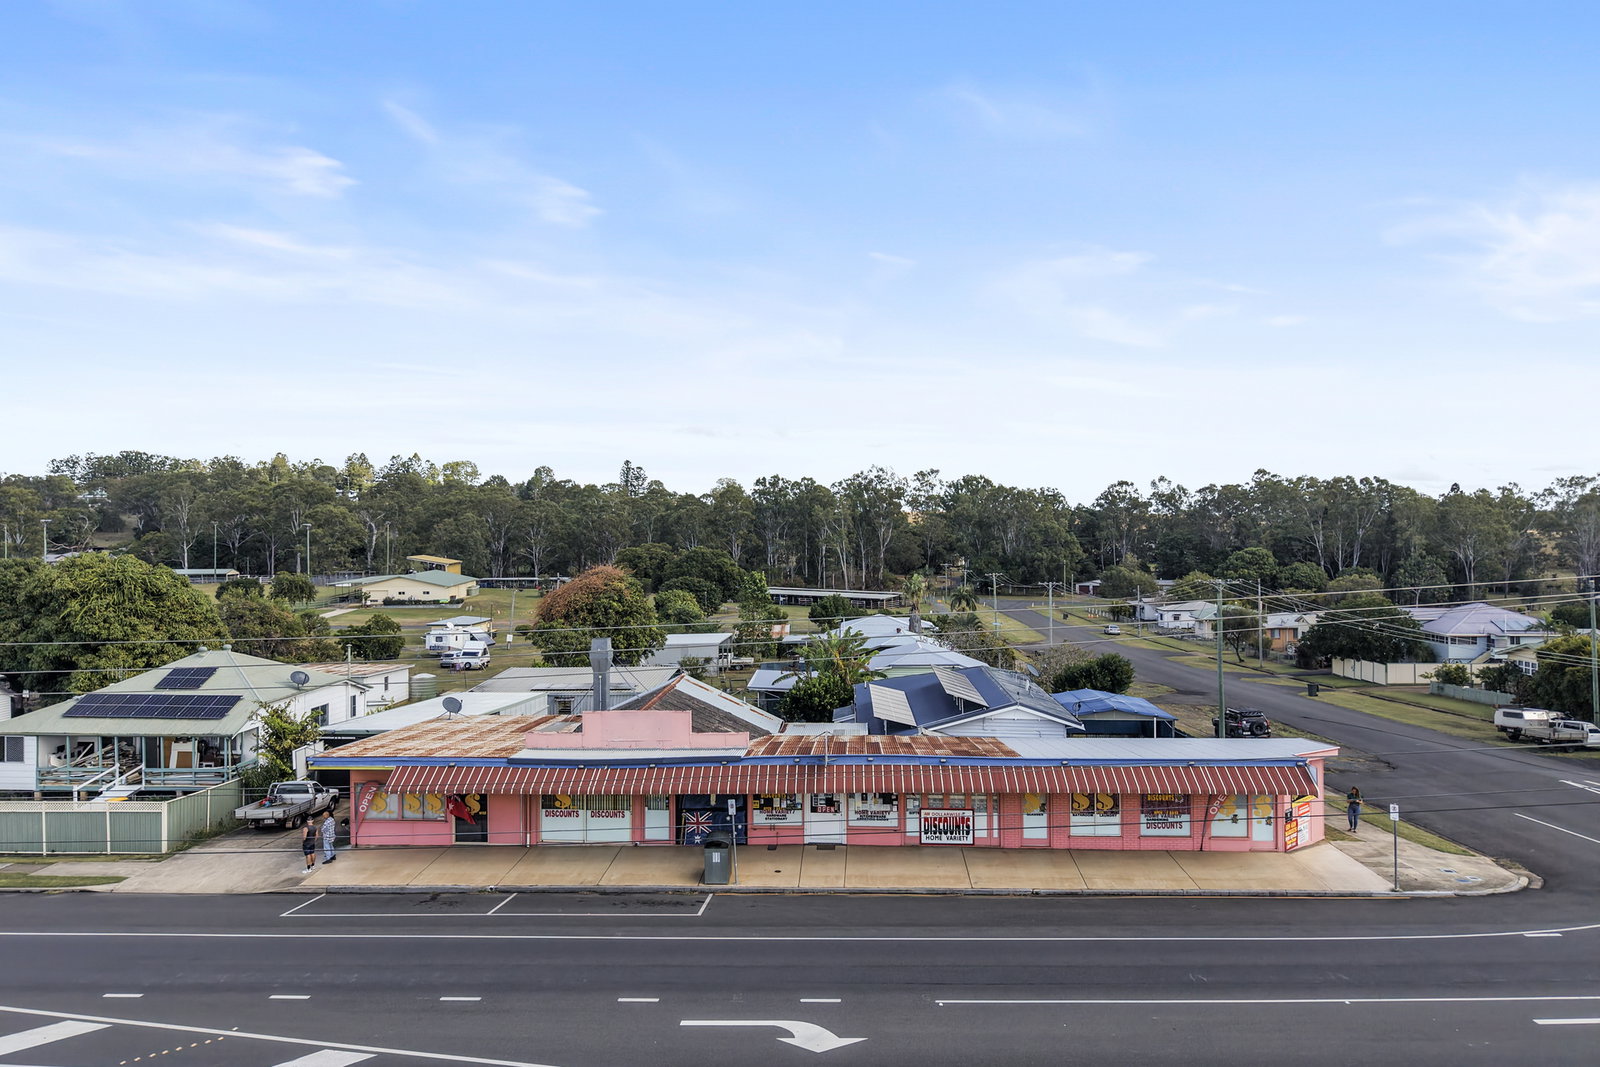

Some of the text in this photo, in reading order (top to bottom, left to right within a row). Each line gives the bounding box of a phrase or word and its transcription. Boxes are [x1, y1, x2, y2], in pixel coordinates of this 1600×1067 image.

[360, 786, 377, 812] OPEN
[1209, 794, 1227, 815] OPE
[545, 809, 580, 818] DISCOUNTS
[590, 810, 626, 819] DISCOUNTS
[923, 816, 971, 836] DISCOUNTS
[1146, 822, 1183, 830] DISCOUNTS
